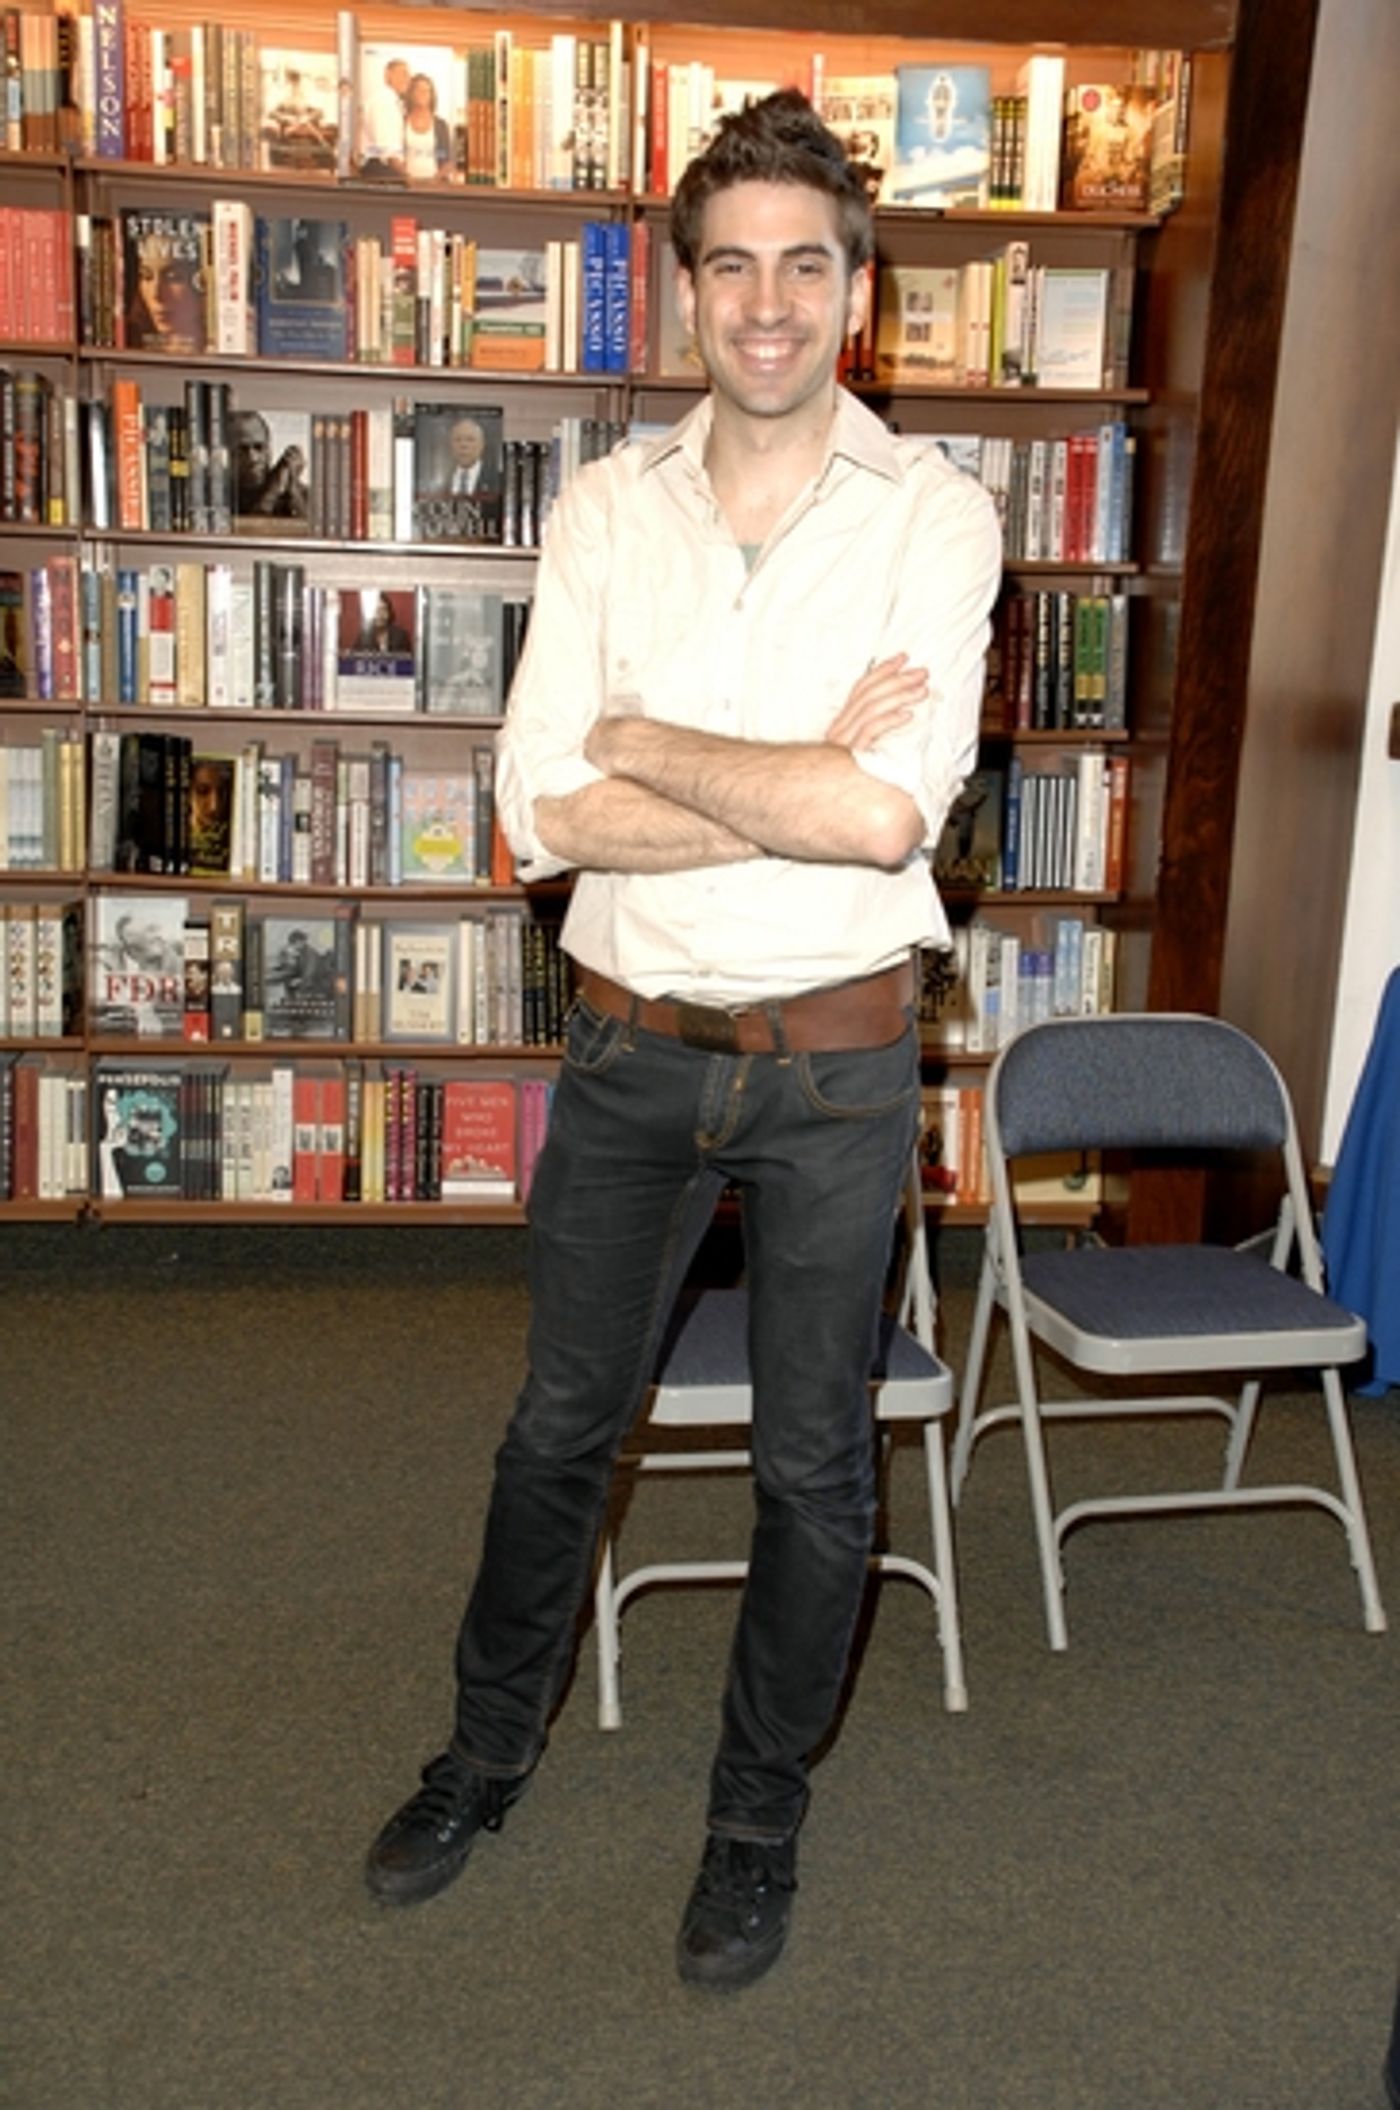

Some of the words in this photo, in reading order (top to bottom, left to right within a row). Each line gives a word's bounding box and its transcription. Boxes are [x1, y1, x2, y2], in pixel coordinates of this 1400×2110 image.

[98, 3, 122, 138] NELSON
[126, 216, 201, 238] STOLEN
[138, 239, 198, 261] LIVES
[587, 257, 603, 353] PICASSO
[611, 257, 628, 353] PICASSO
[104, 975, 179, 1003] FDR
